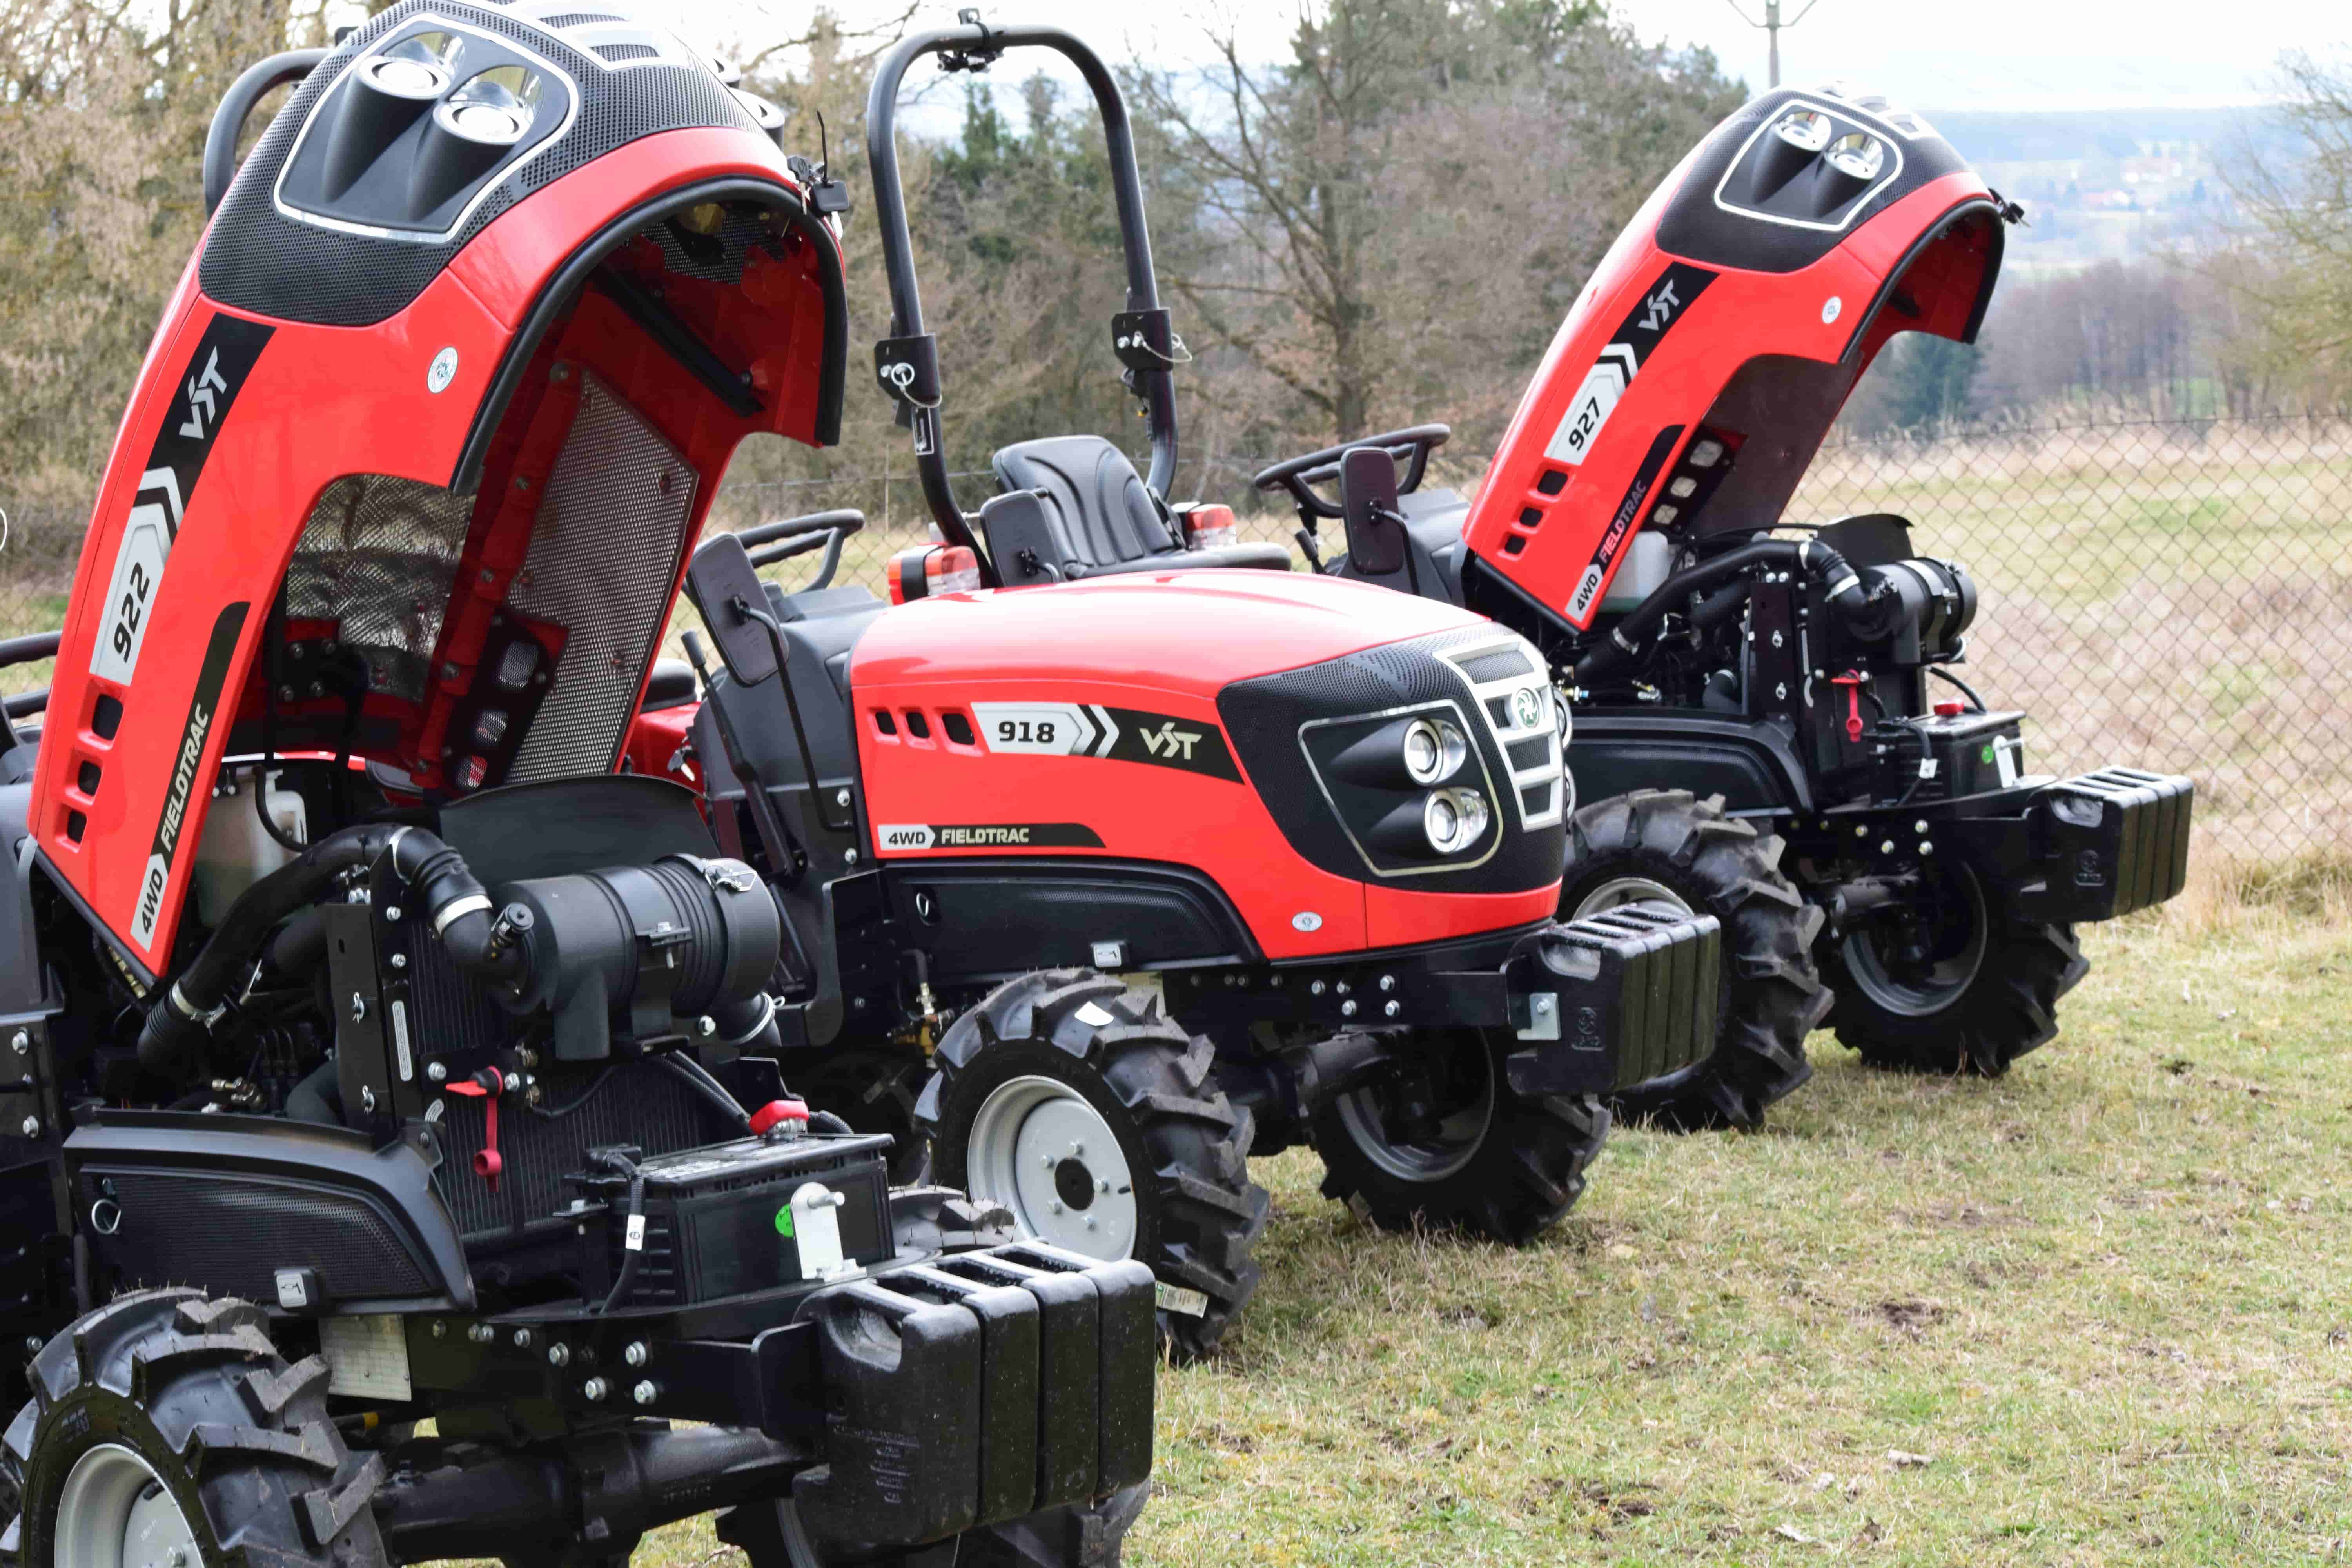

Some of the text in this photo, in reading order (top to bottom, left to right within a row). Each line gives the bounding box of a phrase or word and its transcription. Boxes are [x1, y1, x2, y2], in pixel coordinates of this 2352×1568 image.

[1638, 279, 1681, 332] VST
[179, 345, 227, 439] VST
[1568, 396, 1601, 451] 927
[1576, 479, 1647, 612] 4WD FIELDTRAC
[113, 562, 151, 663] 922
[998, 720, 1055, 744] 918
[1139, 722, 1202, 760] VST
[141, 704, 210, 935] 4WD FIELDTRAC
[887, 827, 1029, 846] 4WD FIELDTRAC
